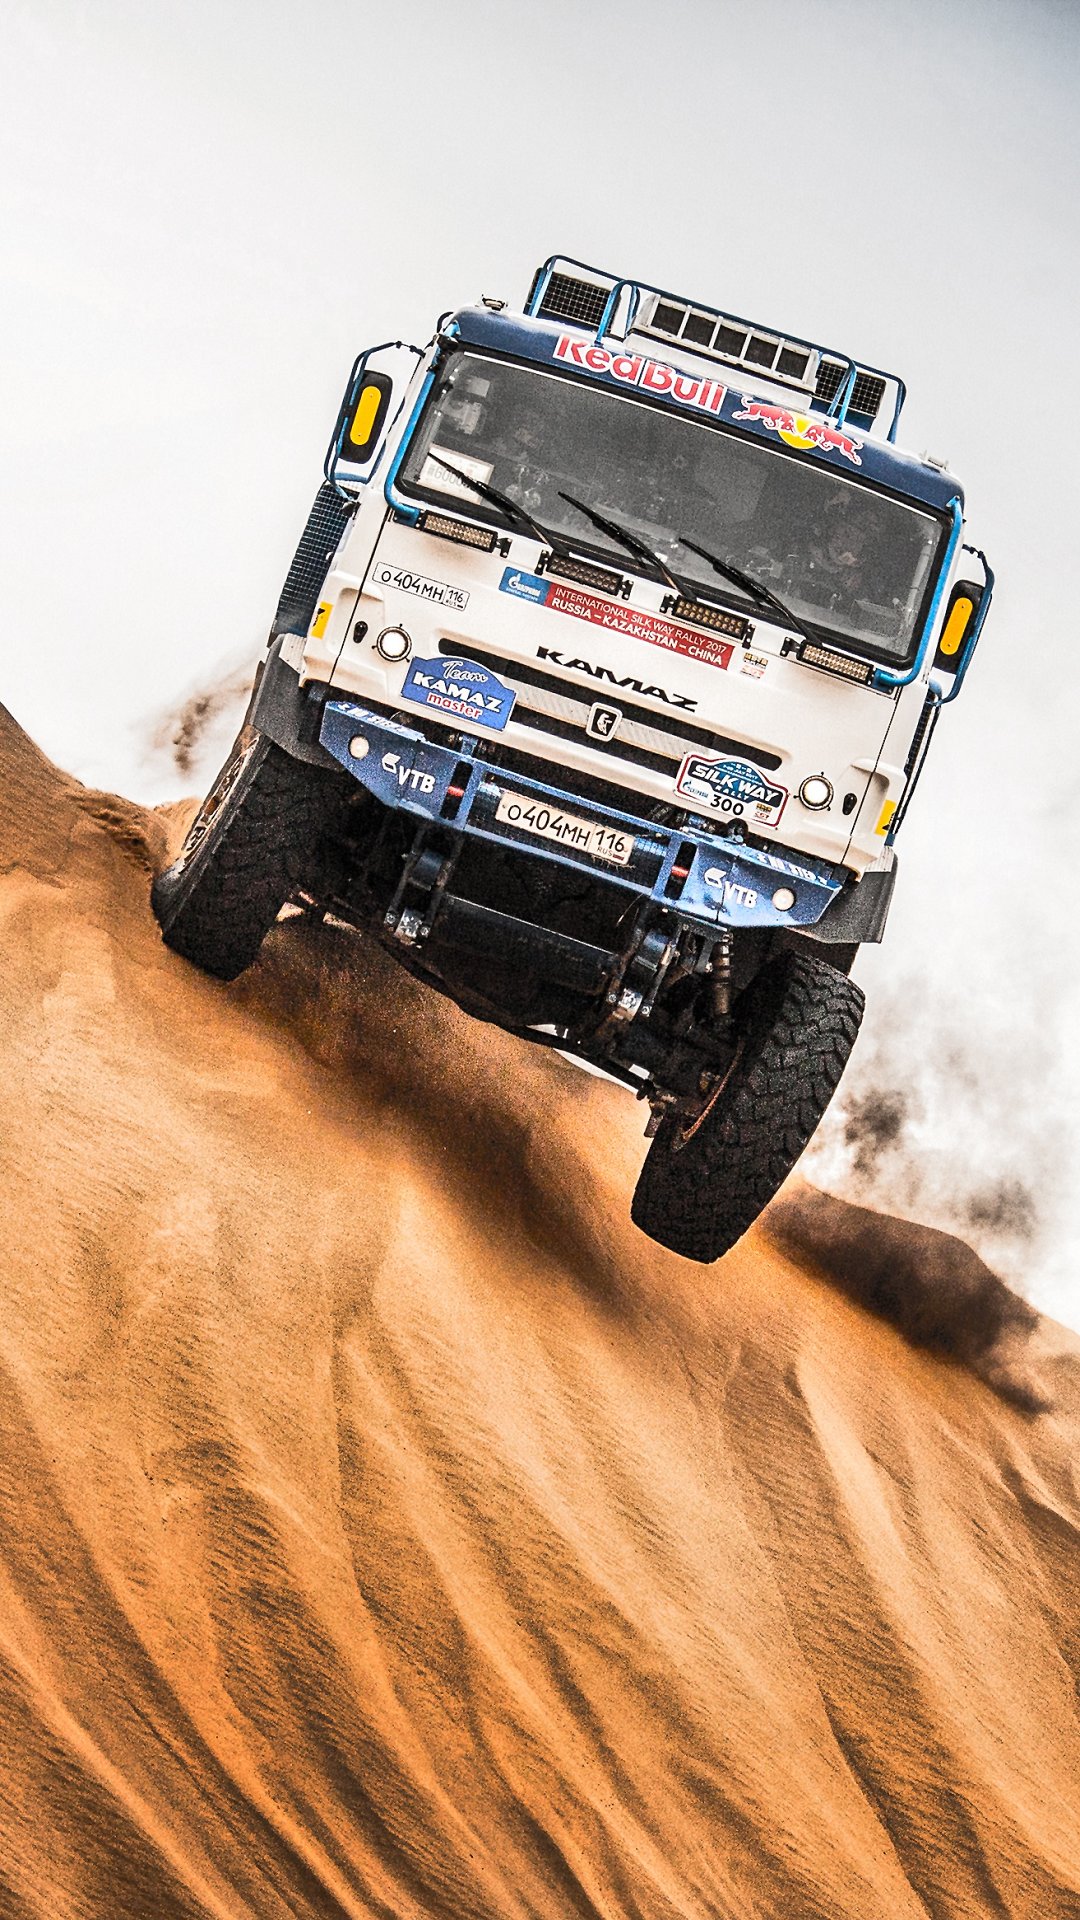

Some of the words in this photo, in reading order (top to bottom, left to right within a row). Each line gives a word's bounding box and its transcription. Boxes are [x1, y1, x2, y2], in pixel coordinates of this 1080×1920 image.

[448, 589, 463, 603] 116
[552, 598, 592, 619] RUSSIA
[602, 615, 678, 649] KAZAKHSTAN
[688, 646, 722, 665] CHINA
[555, 588, 629, 620] INTERNATIONAL
[631, 614, 652, 629] SILK
[653, 621, 675, 635] WAY
[675, 630, 705, 646] RALLY
[706, 641, 727, 654] 2017
[442, 660, 488, 682] Team
[536, 646, 698, 713] KAMAZ
[413, 671, 503, 713] KAMAZ
[428, 693, 483, 718] master
[398, 765, 436, 793] VTB
[692, 764, 737, 791] SILK
[739, 780, 779, 801] WAY
[710, 794, 744, 815] 300
[595, 829, 625, 852] 116
[723, 880, 758, 909] VTB
